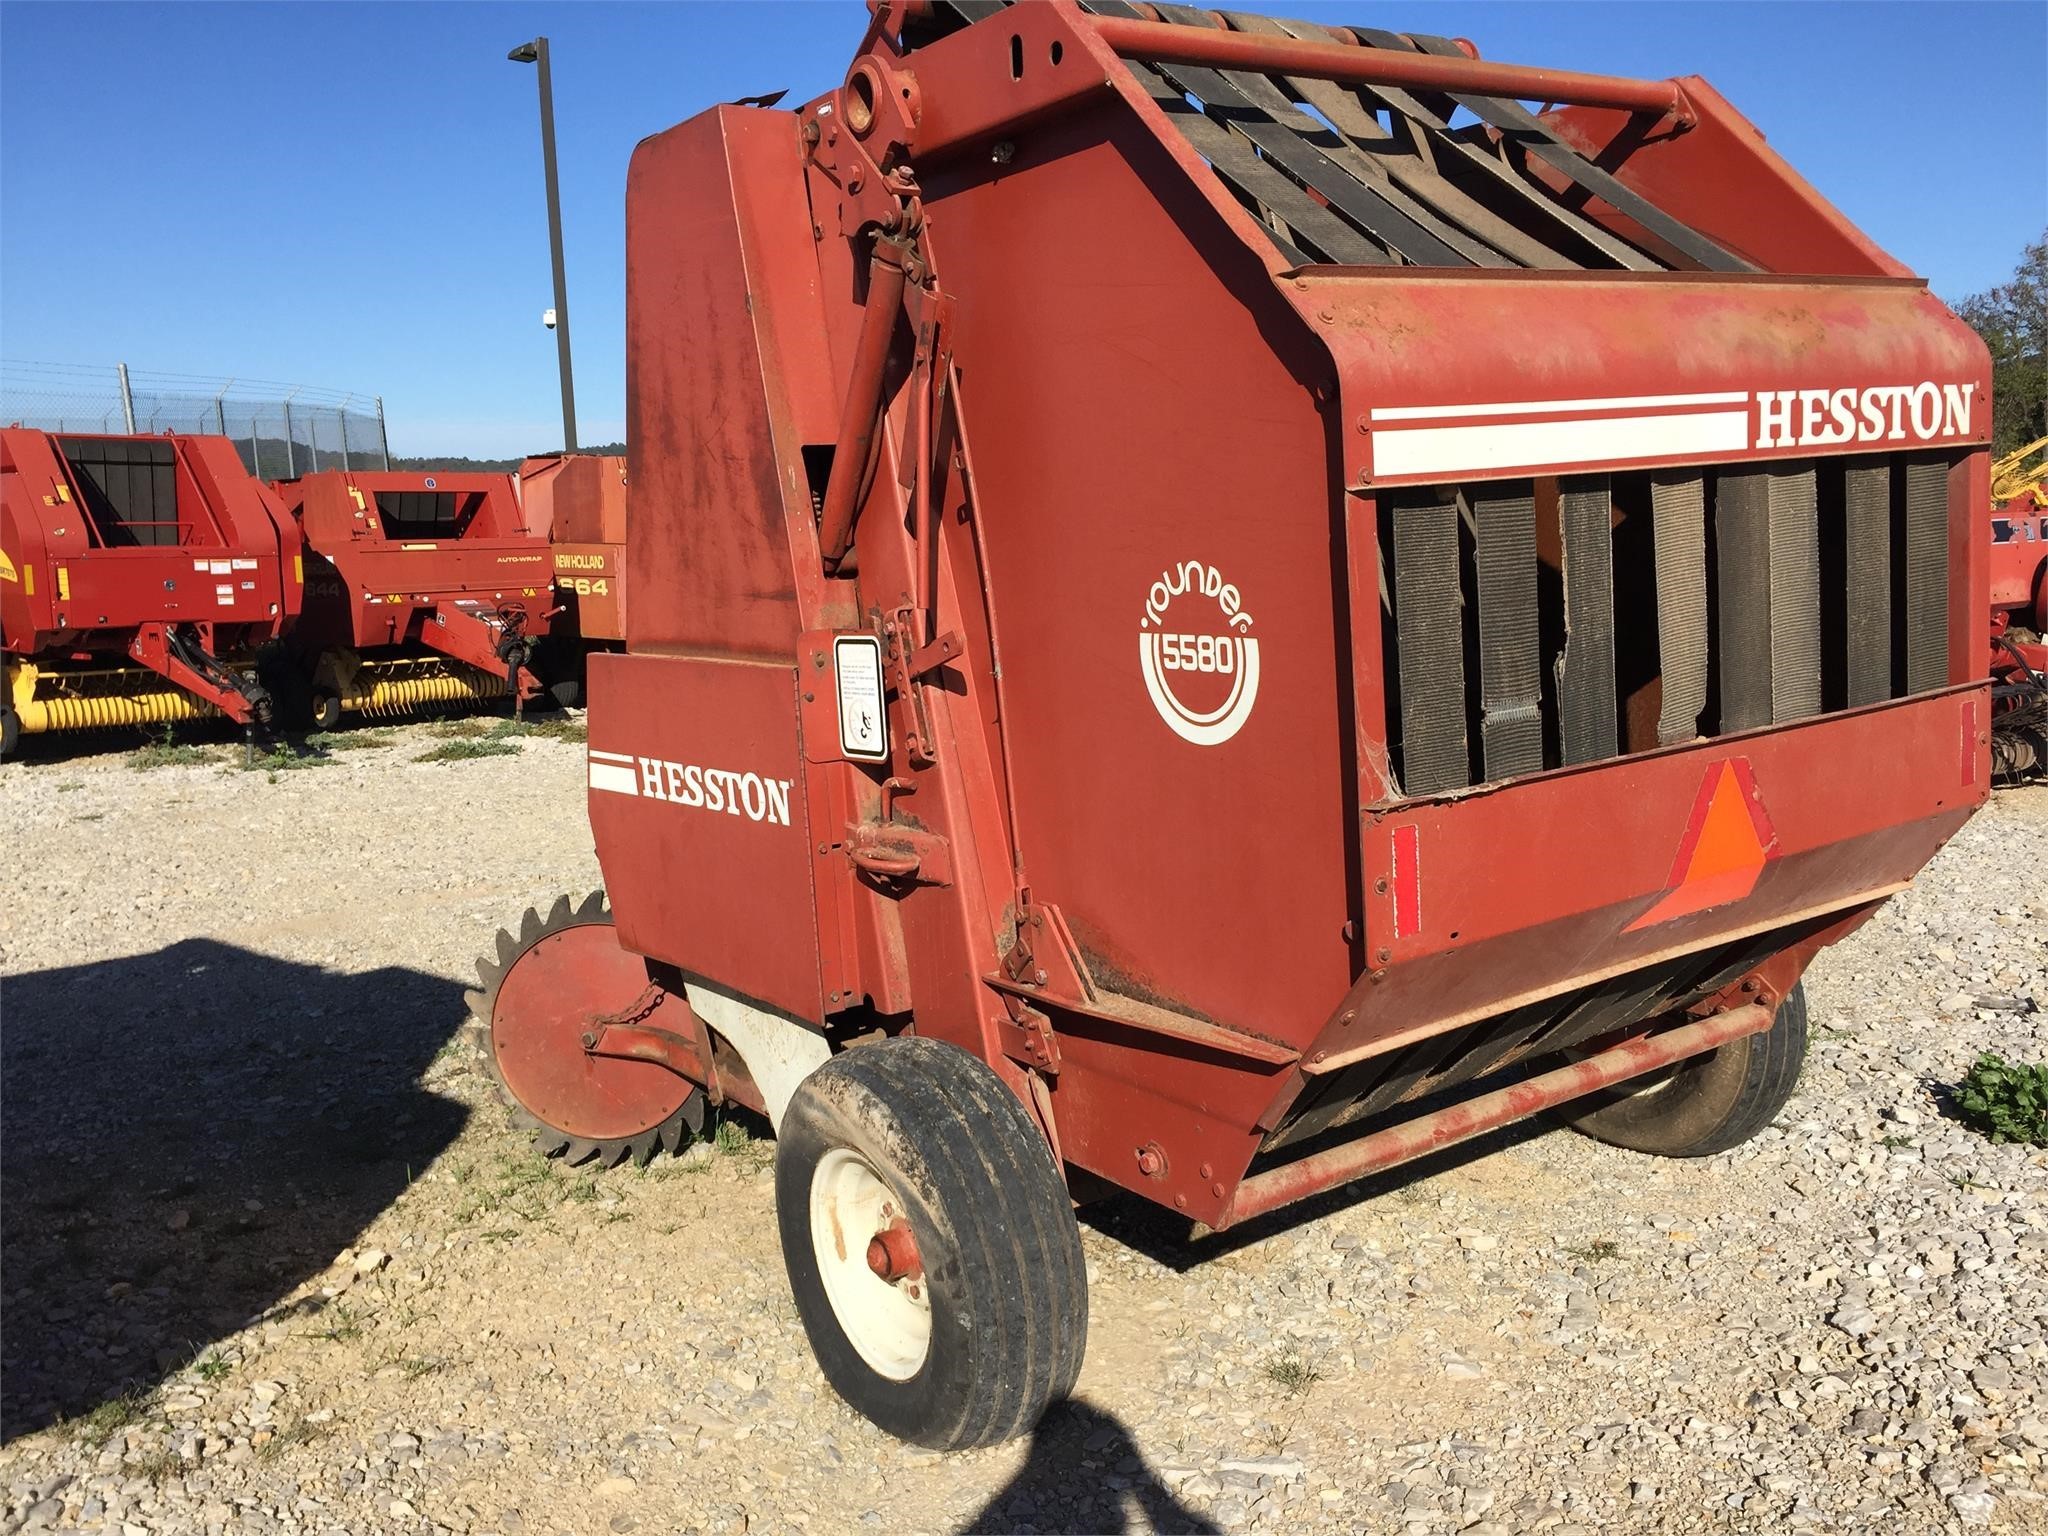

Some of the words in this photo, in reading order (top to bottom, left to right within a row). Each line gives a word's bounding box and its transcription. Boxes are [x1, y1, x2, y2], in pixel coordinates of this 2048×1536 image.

[1755, 381, 1974, 449] HESSTON
[555, 554, 571, 569] NEW
[571, 554, 605, 570] HOLLAND
[559, 577, 609, 596] 664
[1162, 633, 1234, 674] 5580
[638, 756, 791, 827] HESSTON
